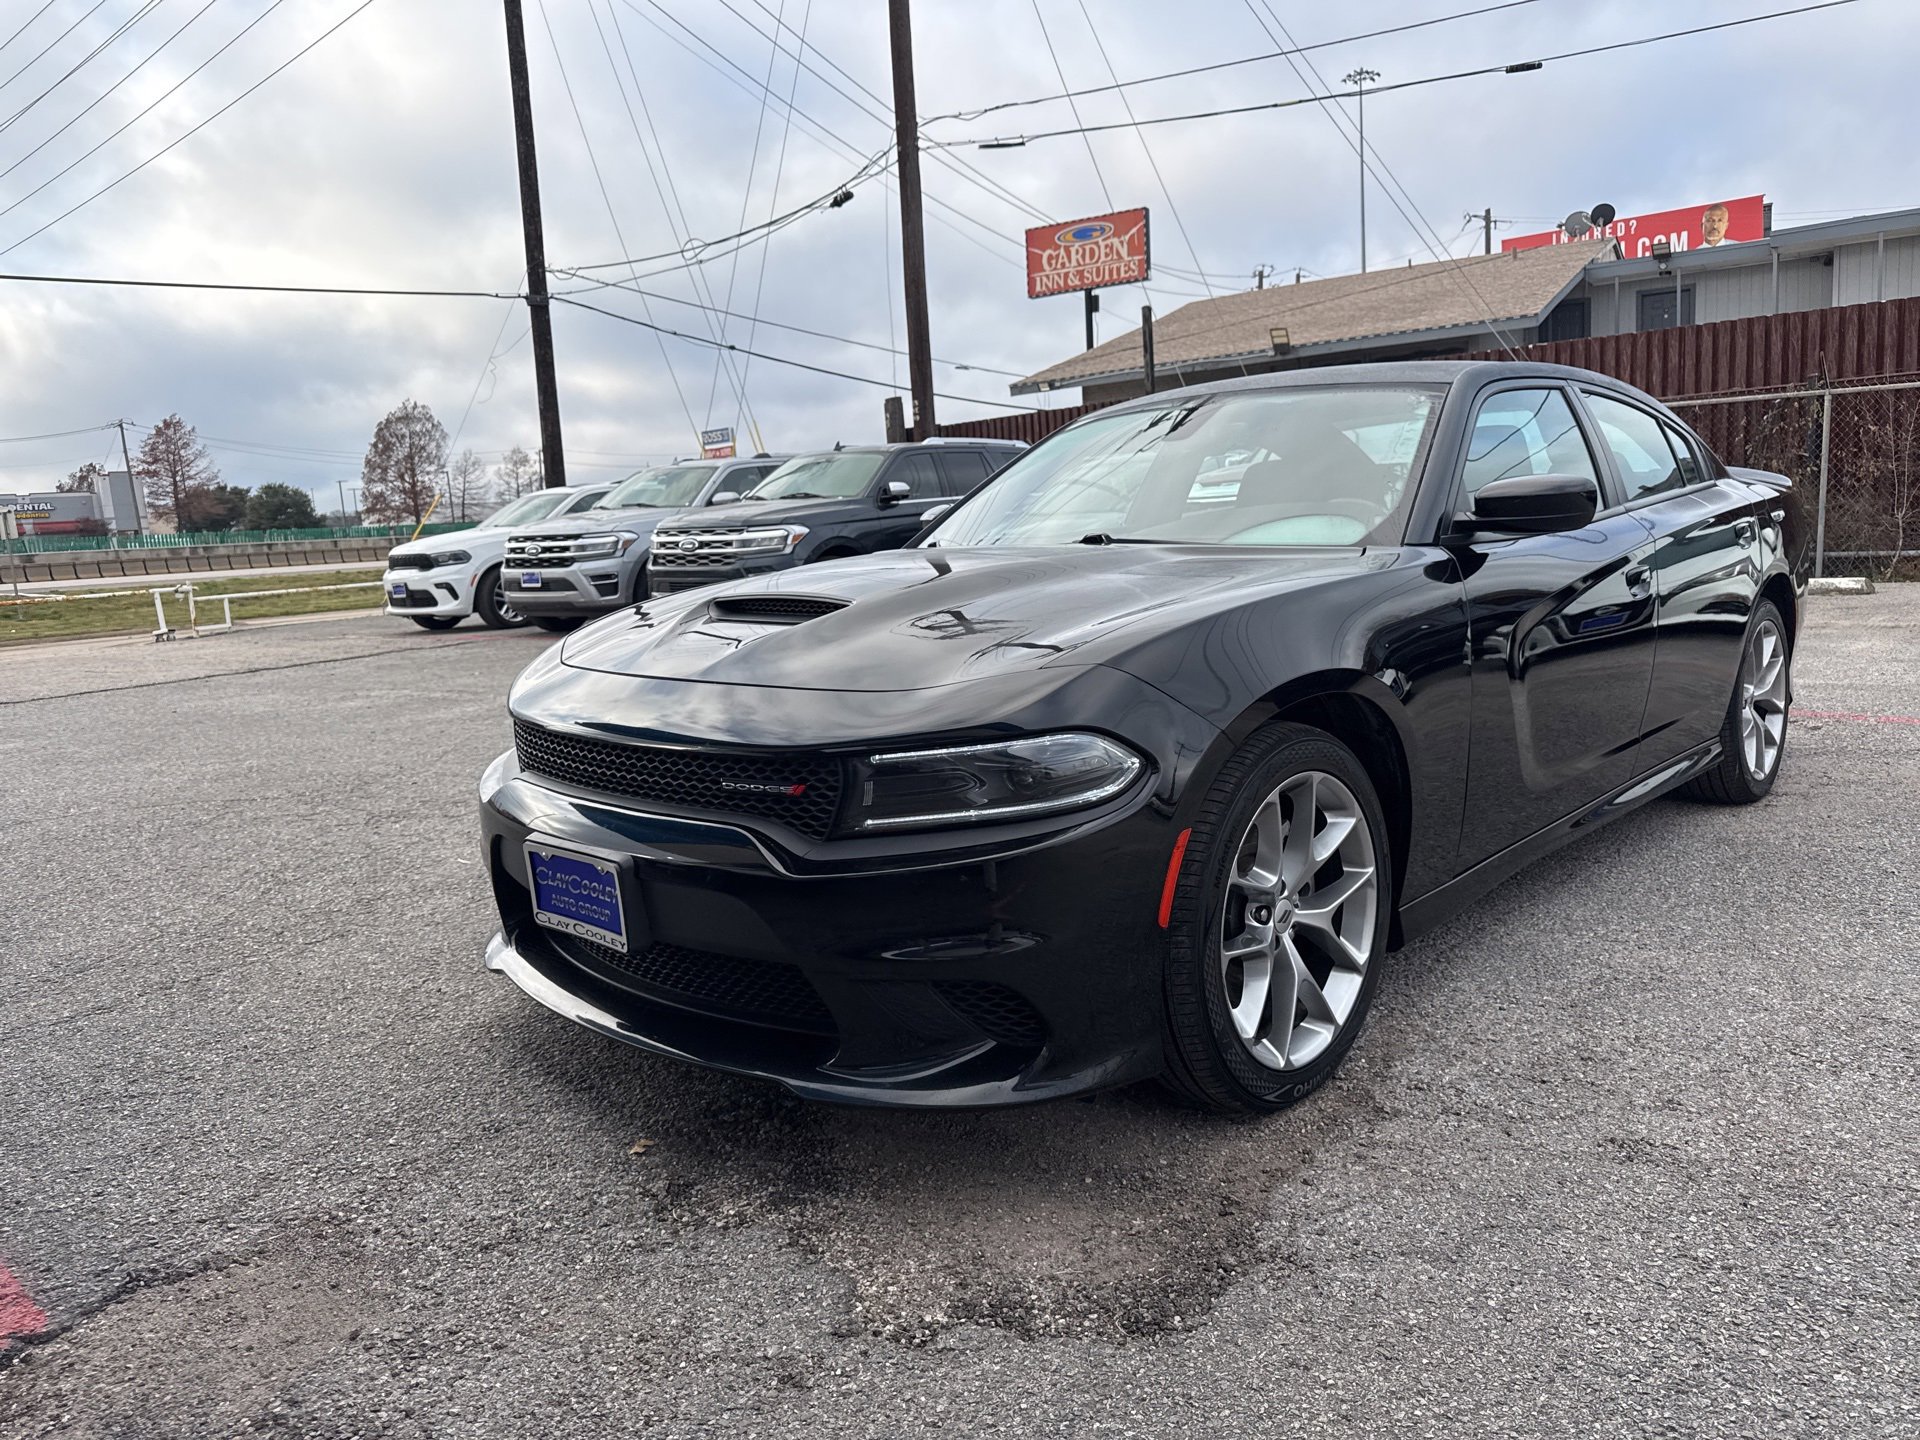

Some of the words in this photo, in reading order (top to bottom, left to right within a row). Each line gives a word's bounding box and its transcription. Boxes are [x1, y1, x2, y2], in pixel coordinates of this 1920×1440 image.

[1552, 219, 1637, 245] INRED?
[1042, 235, 1128, 272] GARDEN
[1035, 272, 1065, 292] INN
[1067, 270, 1081, 286] &
[1083, 260, 1138, 284] SUITES
[7, 502, 55, 511] DENTAL
[721, 782, 795, 793] DODGE
[551, 893, 577, 911] AUTO
[578, 901, 612, 922] GROUP
[535, 911, 571, 930] CLAY
[573, 923, 626, 950] COOLEY
